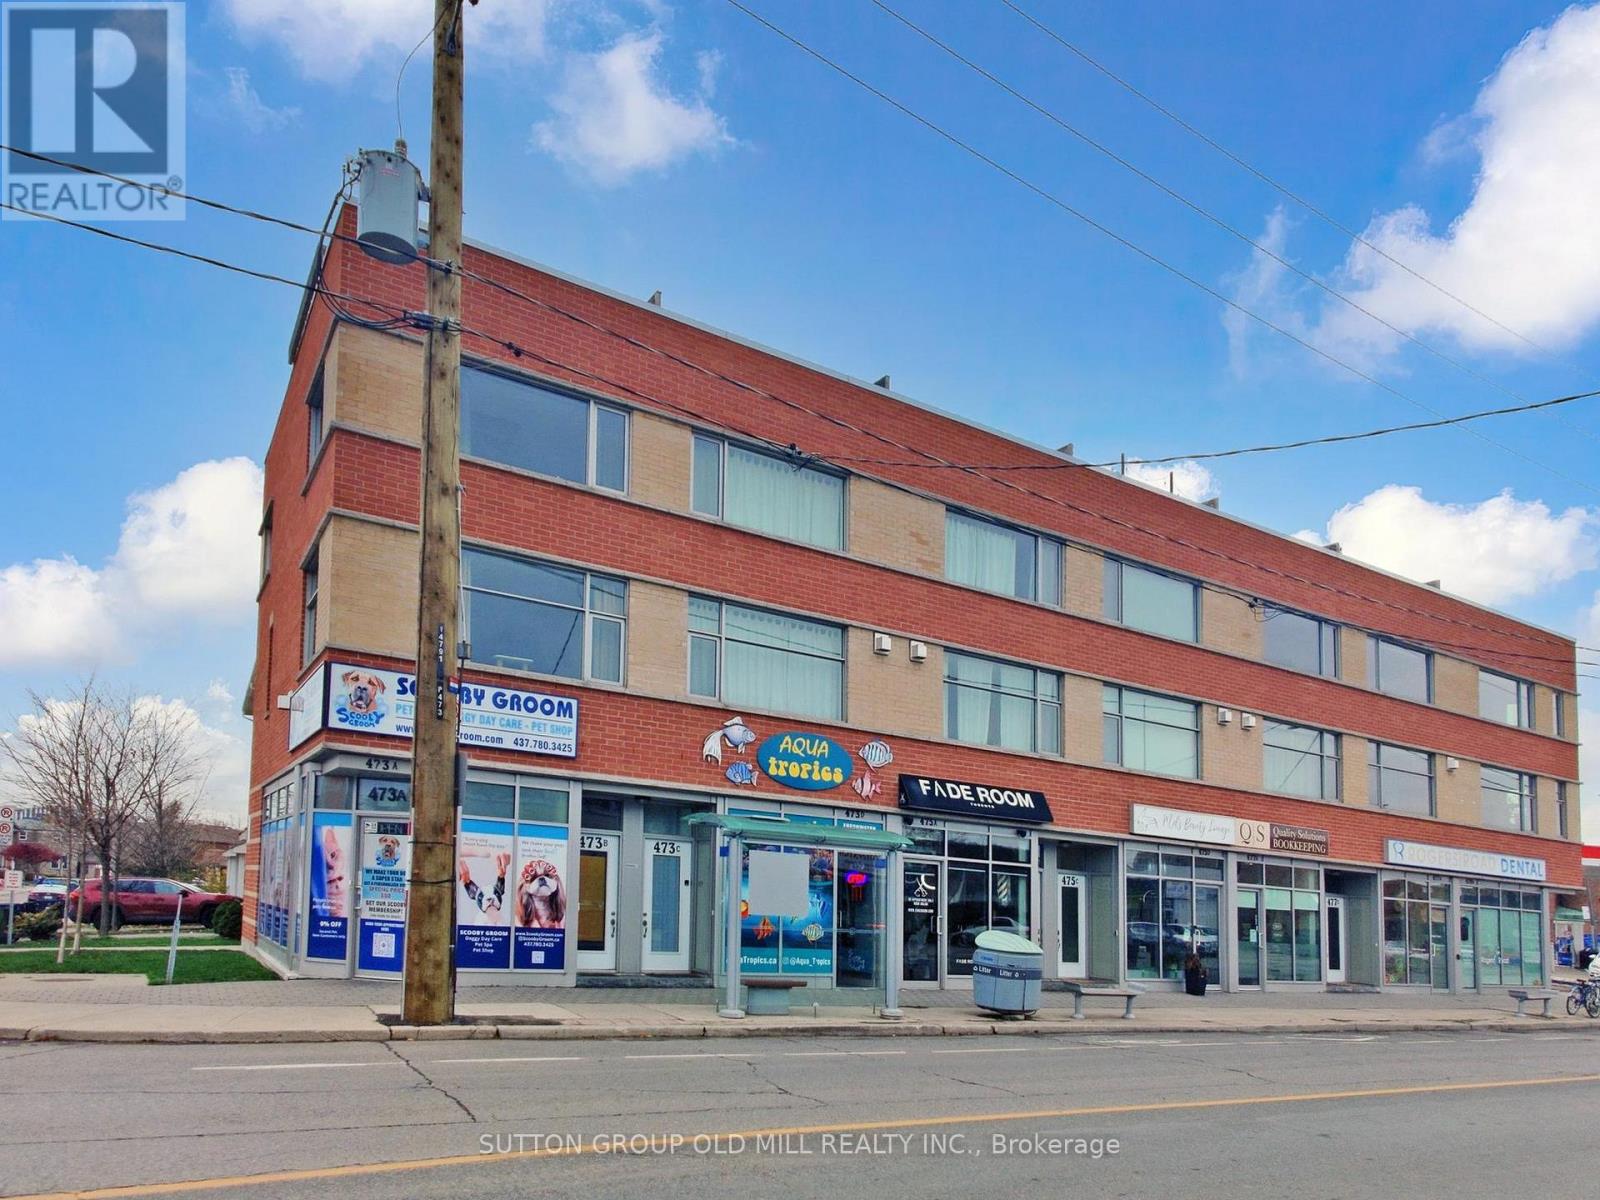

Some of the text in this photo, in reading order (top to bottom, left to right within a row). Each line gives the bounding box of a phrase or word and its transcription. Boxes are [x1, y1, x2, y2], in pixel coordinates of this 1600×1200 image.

[492, 691, 573, 719] GROOM
[396, 703, 413, 716] PET
[500, 717, 522, 730] CARE
[531, 721, 548, 732] PET
[550, 724, 573, 736] SHOP
[513, 737, 573, 753] 437.780.3425
[779, 735, 829, 758] AQUA
[768, 756, 844, 784] tropics
[368, 786, 407, 802] 473A
[976, 786, 1035, 809] ROOM
[1273, 826, 1296, 840] Quality
[1273, 839, 1326, 854] BOOKKEEPING
[1501, 858, 1543, 877] DENTAL
